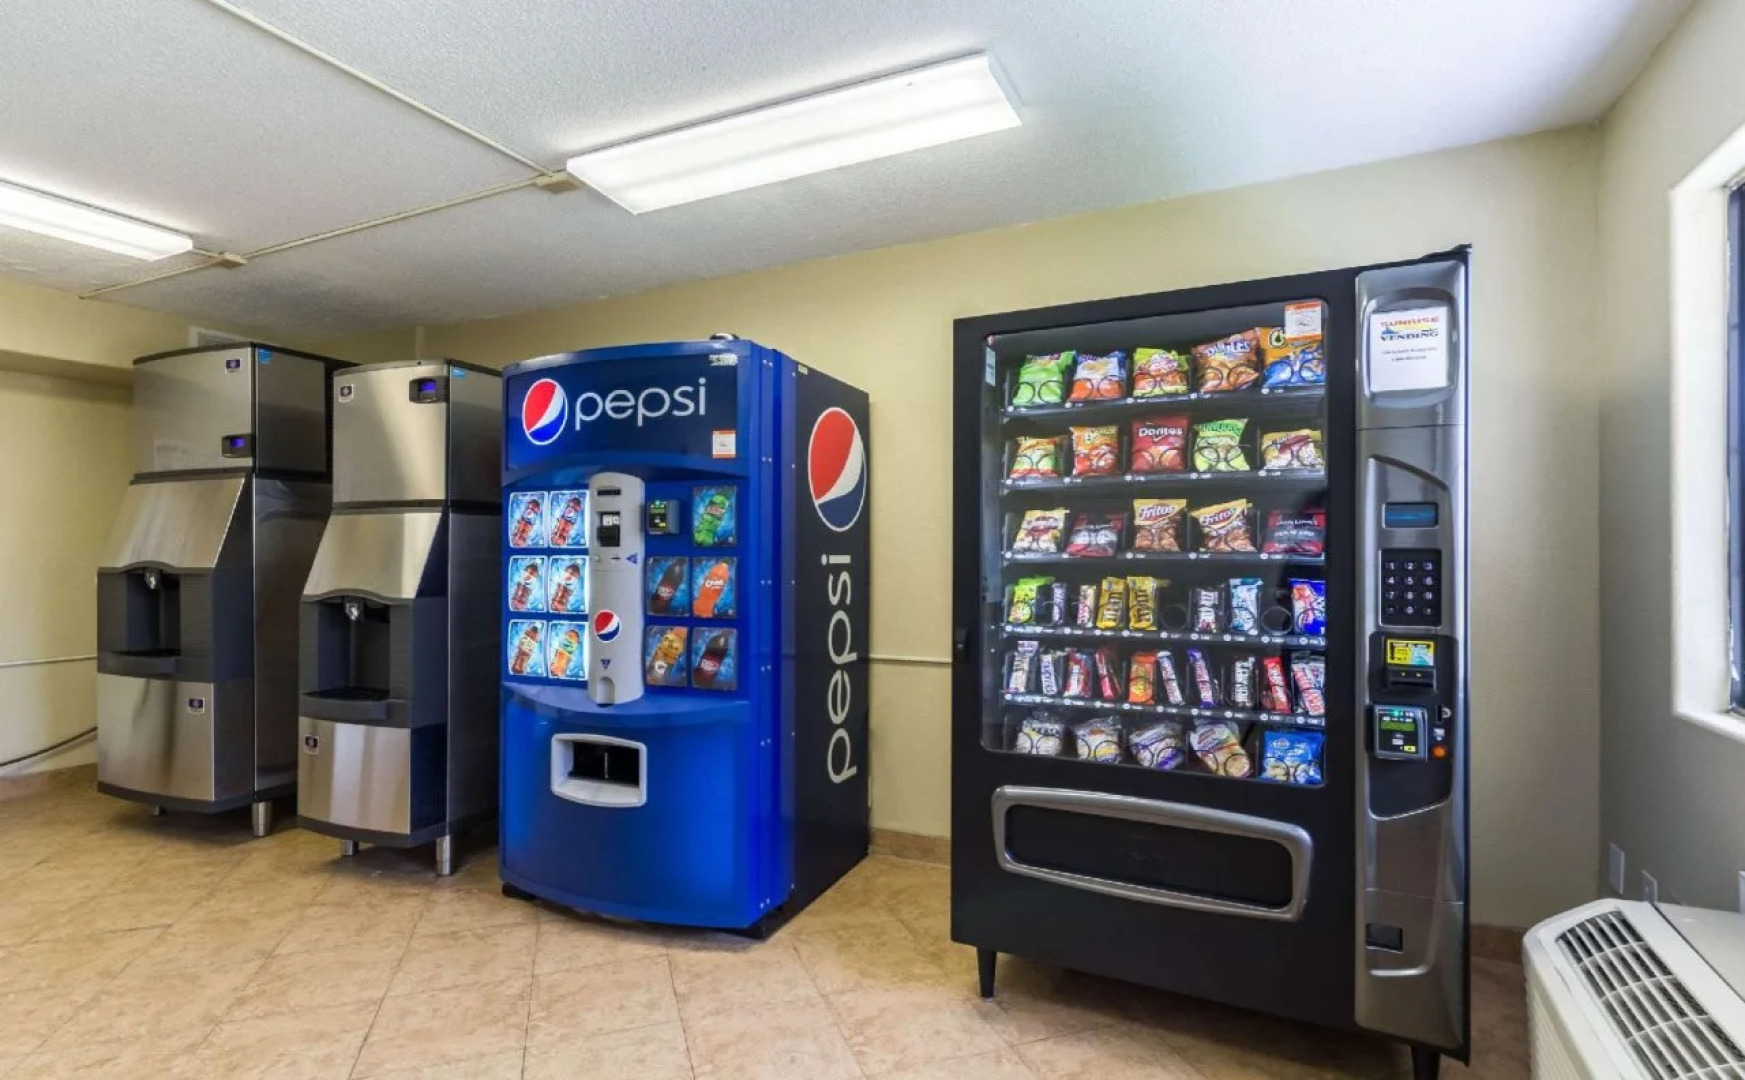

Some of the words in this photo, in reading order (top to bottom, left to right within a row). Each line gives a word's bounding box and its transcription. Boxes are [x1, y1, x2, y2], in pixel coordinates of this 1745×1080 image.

[1380, 329, 1439, 341] VENDING
[575, 377, 706, 431] pepsi
[1139, 427, 1182, 437] Doritos
[1139, 505, 1175, 519] Fritos
[1199, 506, 1237, 525] Fritos
[821, 554, 858, 784] pepsi
